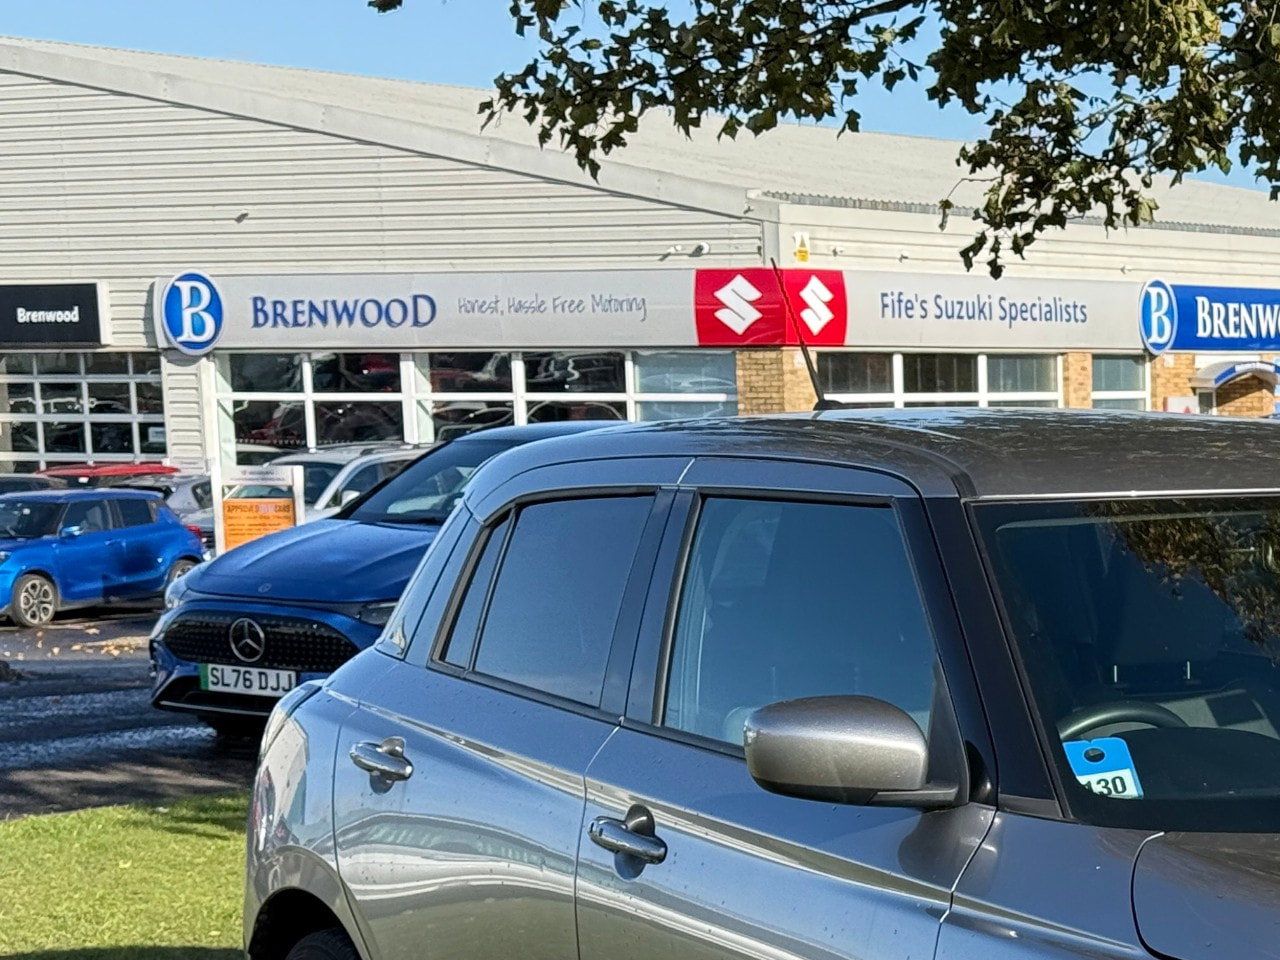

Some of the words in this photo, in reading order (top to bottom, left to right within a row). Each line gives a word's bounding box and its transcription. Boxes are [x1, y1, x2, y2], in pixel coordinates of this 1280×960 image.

[16, 305, 80, 323] Brenwood
[251, 294, 437, 329] BRENWOOD
[457, 295, 504, 316] Honest,
[507, 293, 547, 314] Hassle
[552, 295, 585, 314] Free
[591, 294, 647, 322] Motoring
[880, 291, 928, 319] Fife's
[934, 294, 993, 321] Suzuki
[999, 296, 1088, 329] Specialists
[210, 667, 253, 689] SL76
[258, 671, 293, 692] DJJ
